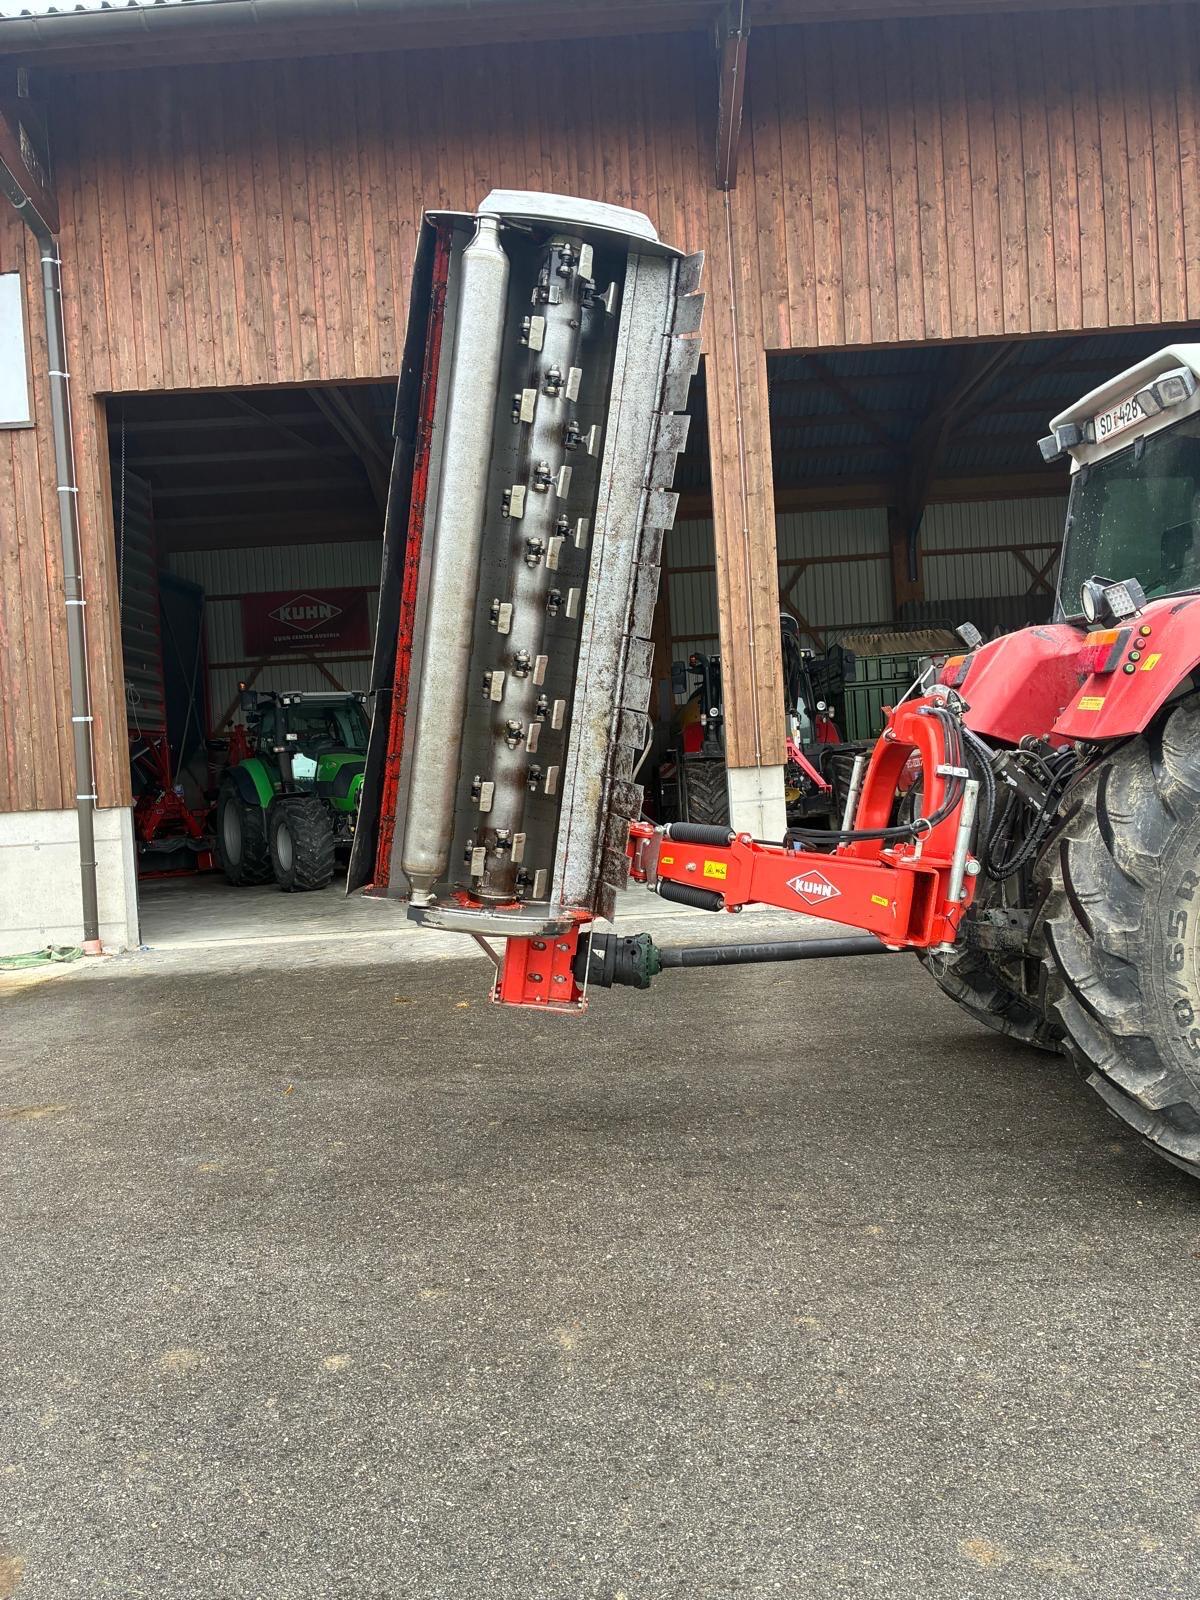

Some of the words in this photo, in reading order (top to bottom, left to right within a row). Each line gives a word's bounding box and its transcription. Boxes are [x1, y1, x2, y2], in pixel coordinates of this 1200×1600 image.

[1100, 414, 1113, 436] SD
[280, 605, 331, 620] KUHN
[795, 878, 832, 897] KUHN
